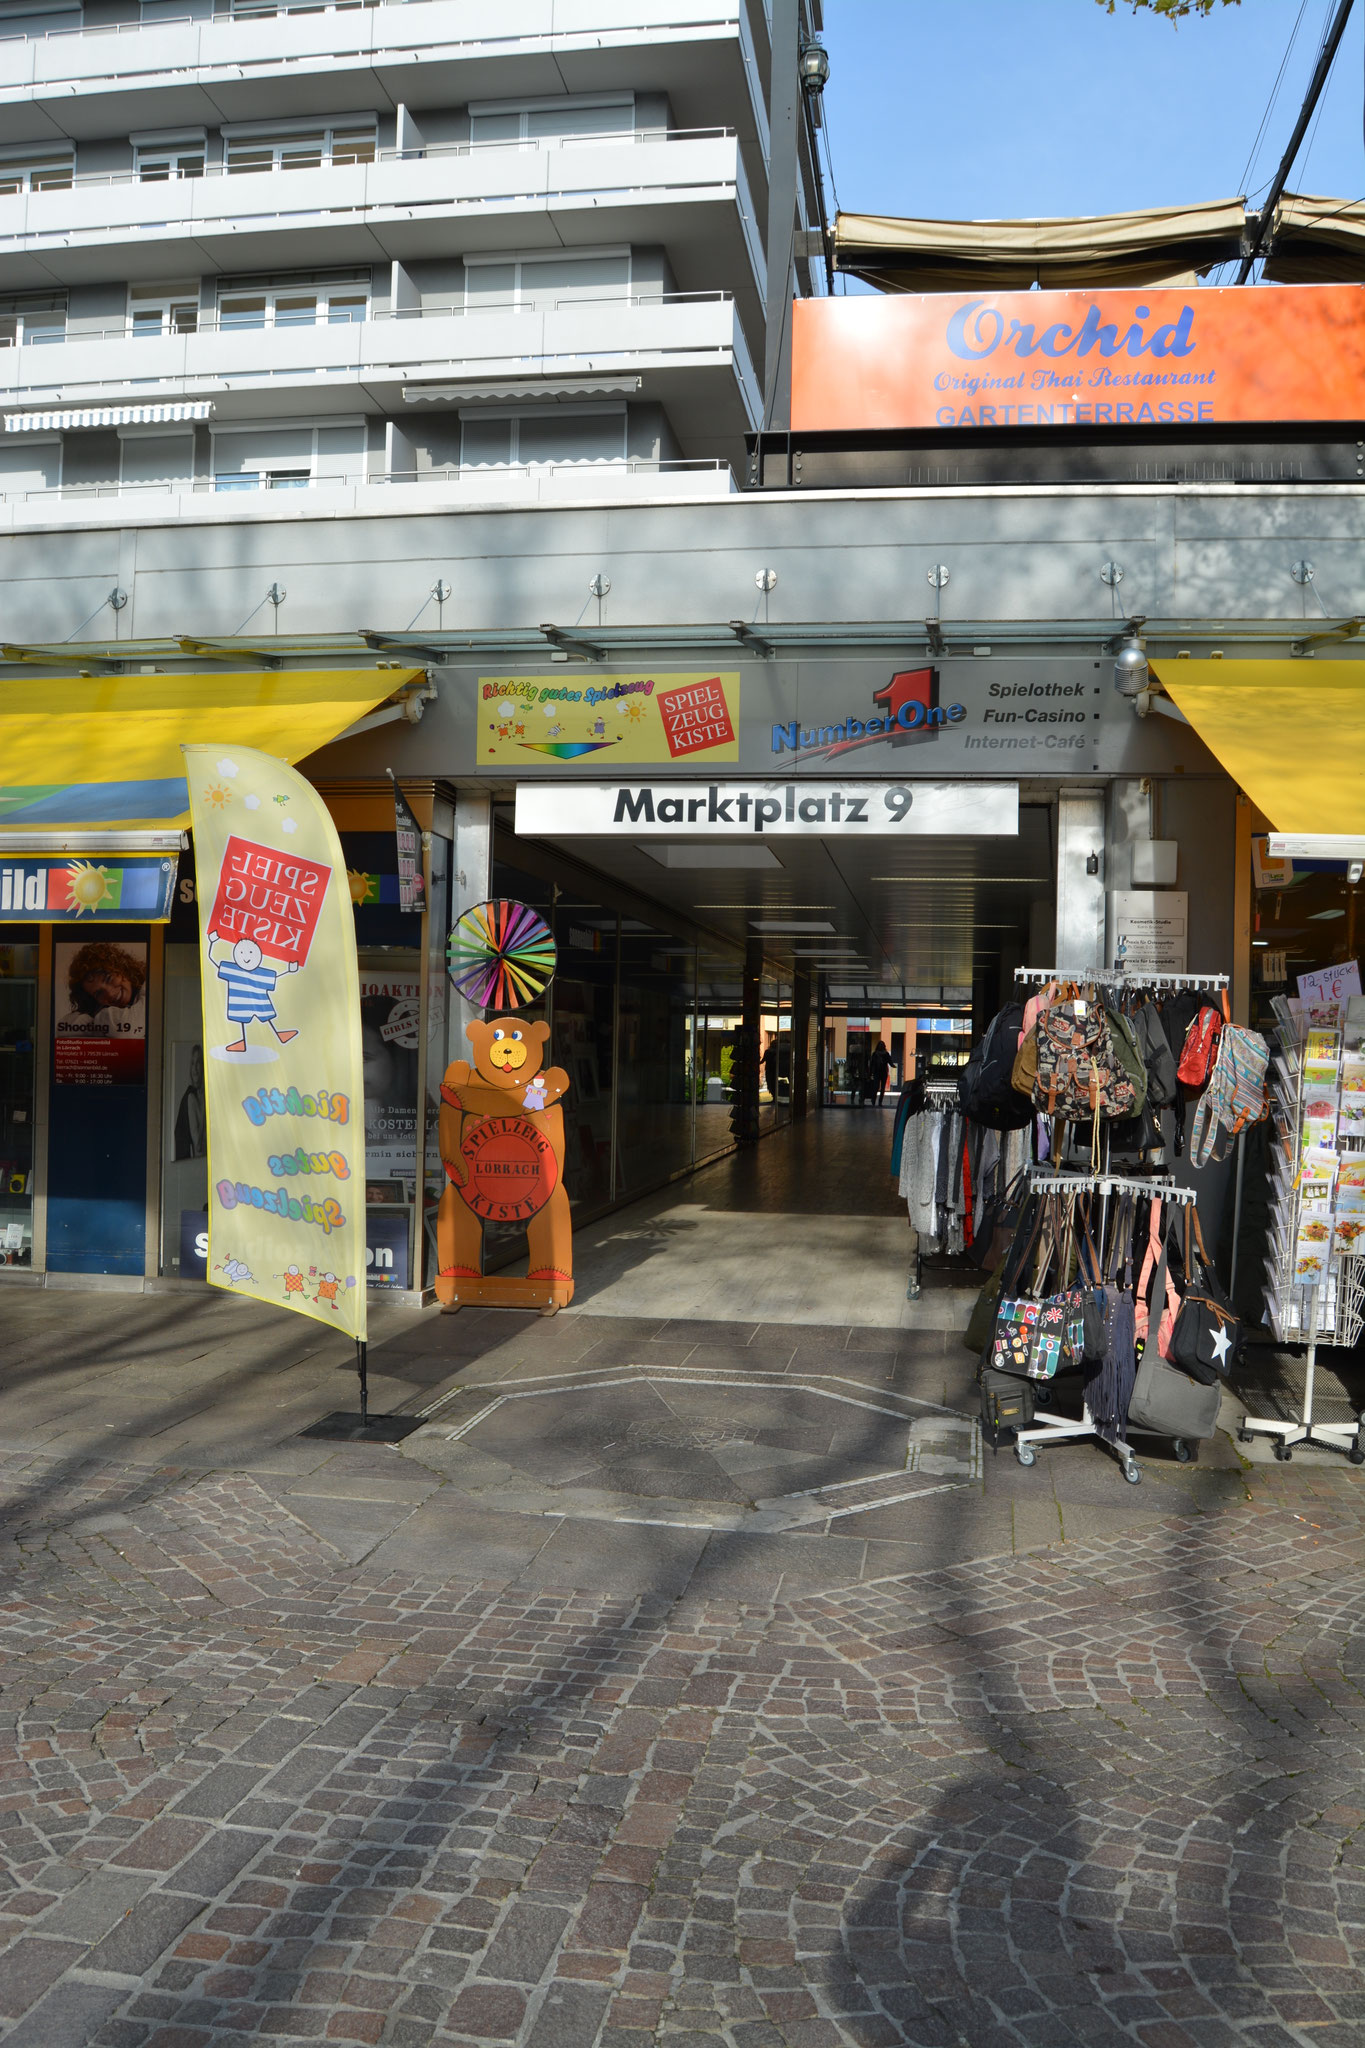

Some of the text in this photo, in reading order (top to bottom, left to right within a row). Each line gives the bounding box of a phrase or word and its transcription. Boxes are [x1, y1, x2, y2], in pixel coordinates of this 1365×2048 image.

[946, 300, 1196, 360] Orchid
[934, 366, 1216, 396] Original Thai Restaurant
[936, 400, 1214, 426] GARTENTERRASSE
[482, 680, 655, 706] Richtig gutes Spielzeug
[664, 686, 720, 713] SPIEL-
[988, 682, 1085, 698] Spielothek
[668, 702, 724, 732] ZEUG
[984, 708, 1086, 723] Fun-Casino
[672, 722, 728, 750] KISTE
[964, 734, 1086, 750] Internet-Café
[613, 786, 914, 832] Marktplatz 9
[57, 1022, 110, 1034] Shooting
[116, 1023, 131, 1032] 19
[384, 1018, 412, 1036] GIRLS
[462, 1120, 548, 1160] SPIELZEUG
[470, 1194, 538, 1218] KISTE
